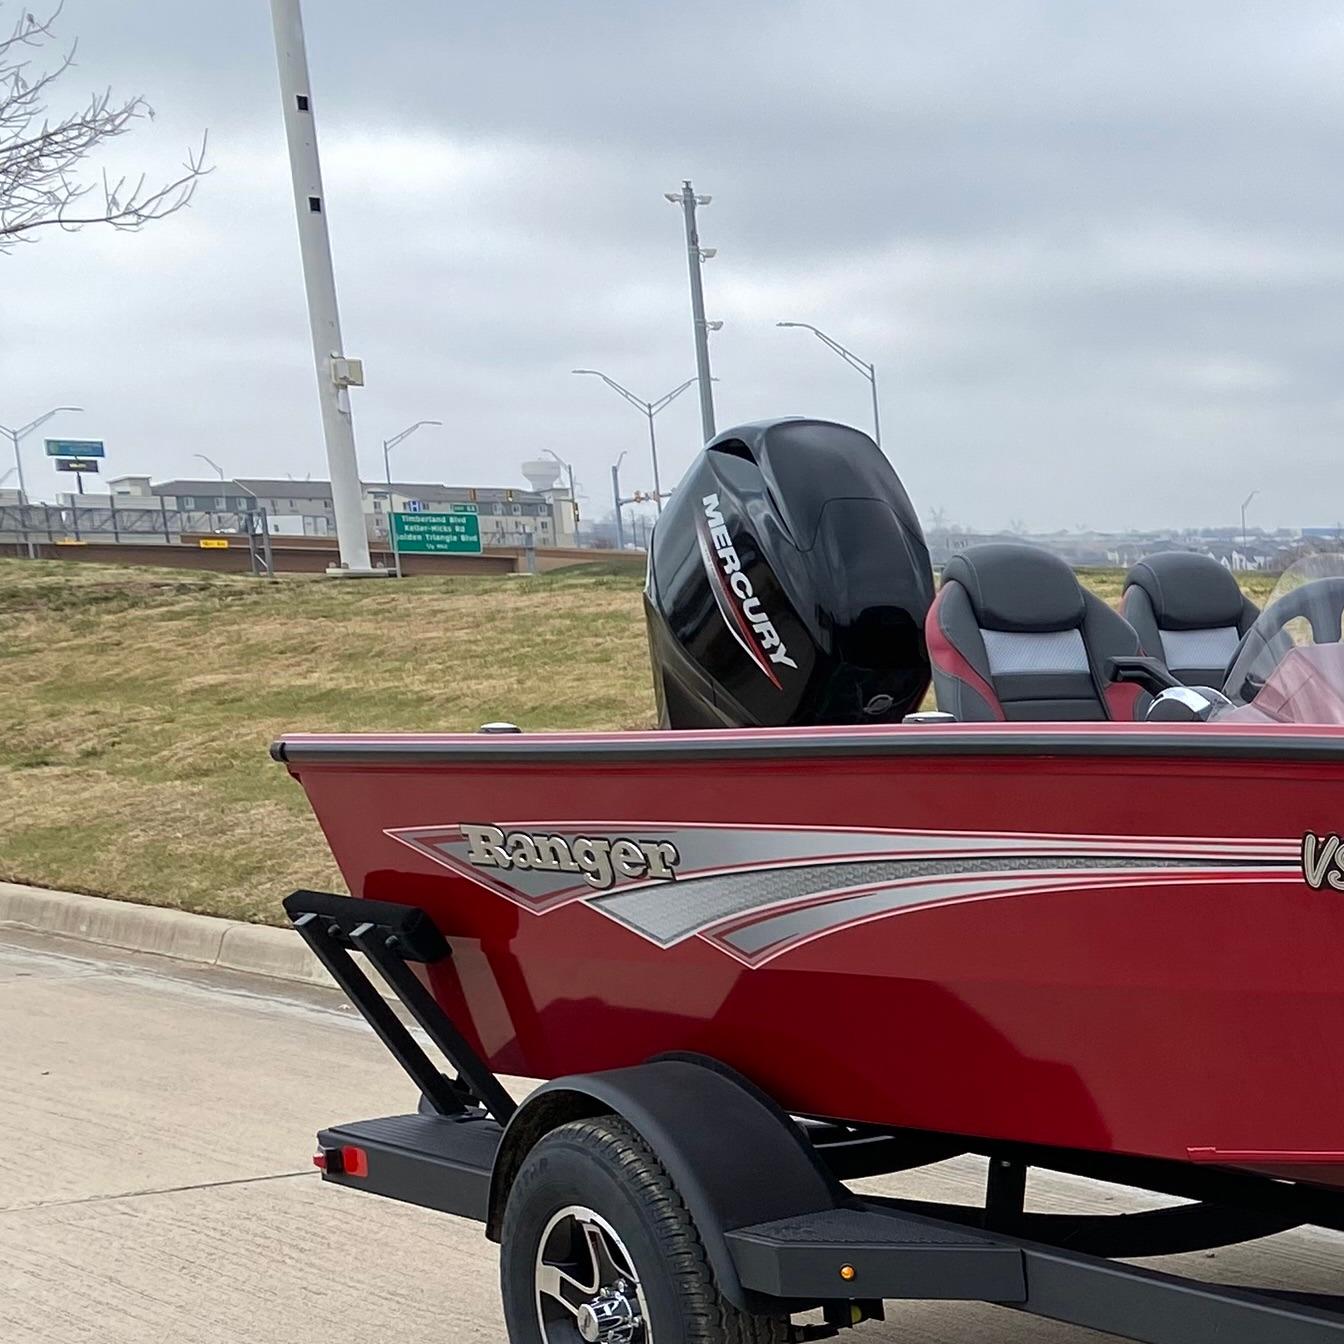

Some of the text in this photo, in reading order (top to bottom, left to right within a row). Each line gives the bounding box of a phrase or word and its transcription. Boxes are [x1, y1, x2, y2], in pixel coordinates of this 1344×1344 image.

[398, 533, 478, 543] olden Triangle Blvd
[401, 515, 466, 524] Timberland Blvd
[702, 493, 798, 669] MERCURY
[459, 822, 680, 889] Ranger
